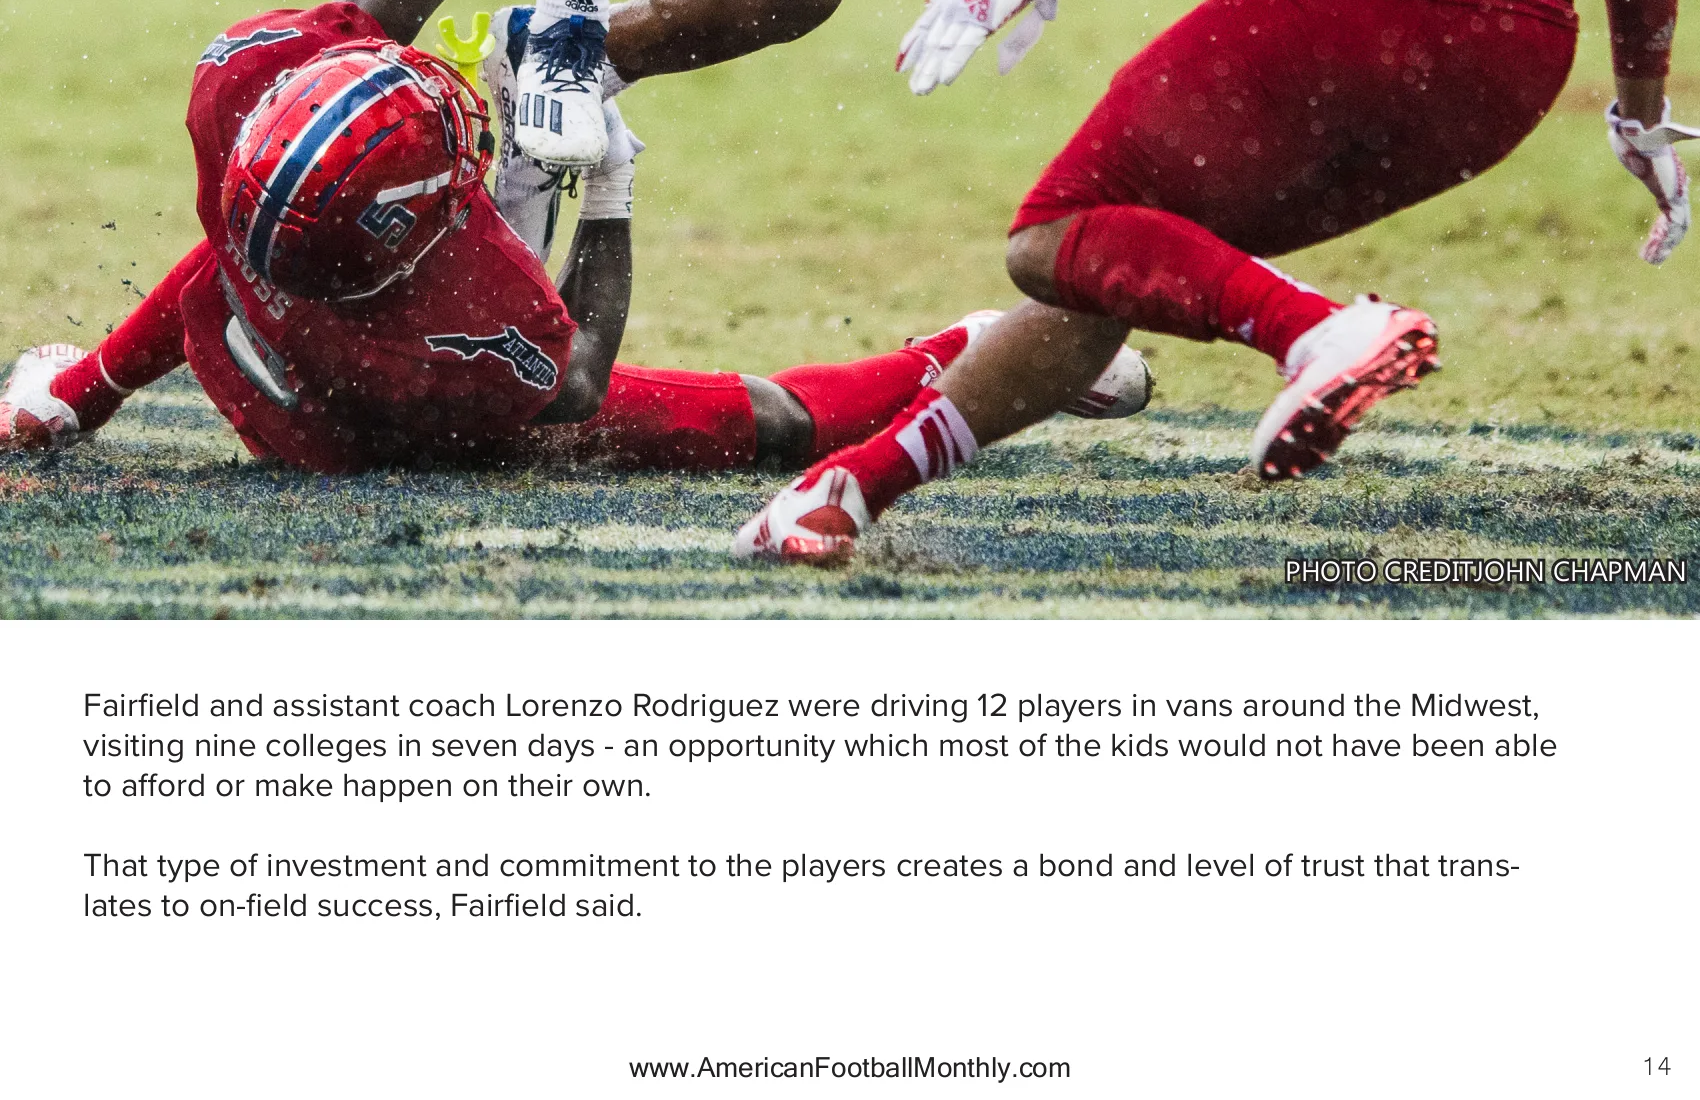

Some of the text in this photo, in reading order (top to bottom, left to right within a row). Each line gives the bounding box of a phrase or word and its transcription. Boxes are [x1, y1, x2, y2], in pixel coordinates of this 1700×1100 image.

[565, 0, 598, 12] adidas
[85, 693, 1538, 723] Fairfield and assistant coach Lorenzo Rodriguez were driving 12 players in vans around the Midwest,
[83, 734, 183, 763] visiting
[196, 734, 255, 757] nine
[266, 734, 386, 763] colleges
[399, 734, 420, 756] in
[432, 739, 516, 757] seven
[528, 734, 594, 763] days
[624, 739, 657, 757] an
[669, 734, 835, 763] opportunity
[844, 734, 927, 757] which
[940, 735, 1008, 757] most
[1019, 733, 1047, 757] of
[1055, 734, 1100, 757] the
[1112, 734, 1168, 757] kids
[1178, 734, 1265, 757] would
[1277, 735, 1322, 757] not
[1333, 734, 1400, 757] have
[1413, 734, 1483, 757] been
[1495, 734, 1556, 757] able
[83, 773, 650, 802] to afford or make happen on their own.
[84, 853, 1519, 883] That type of investment and commitment to the players creates a bond and level of trust that trans-
[85, 893, 641, 920] lates to on-field success, Fairfield said.
[629, 1057, 1070, 1083] www.AmericanFootballMonthly.com
[1645, 1057, 1671, 1075] 14
